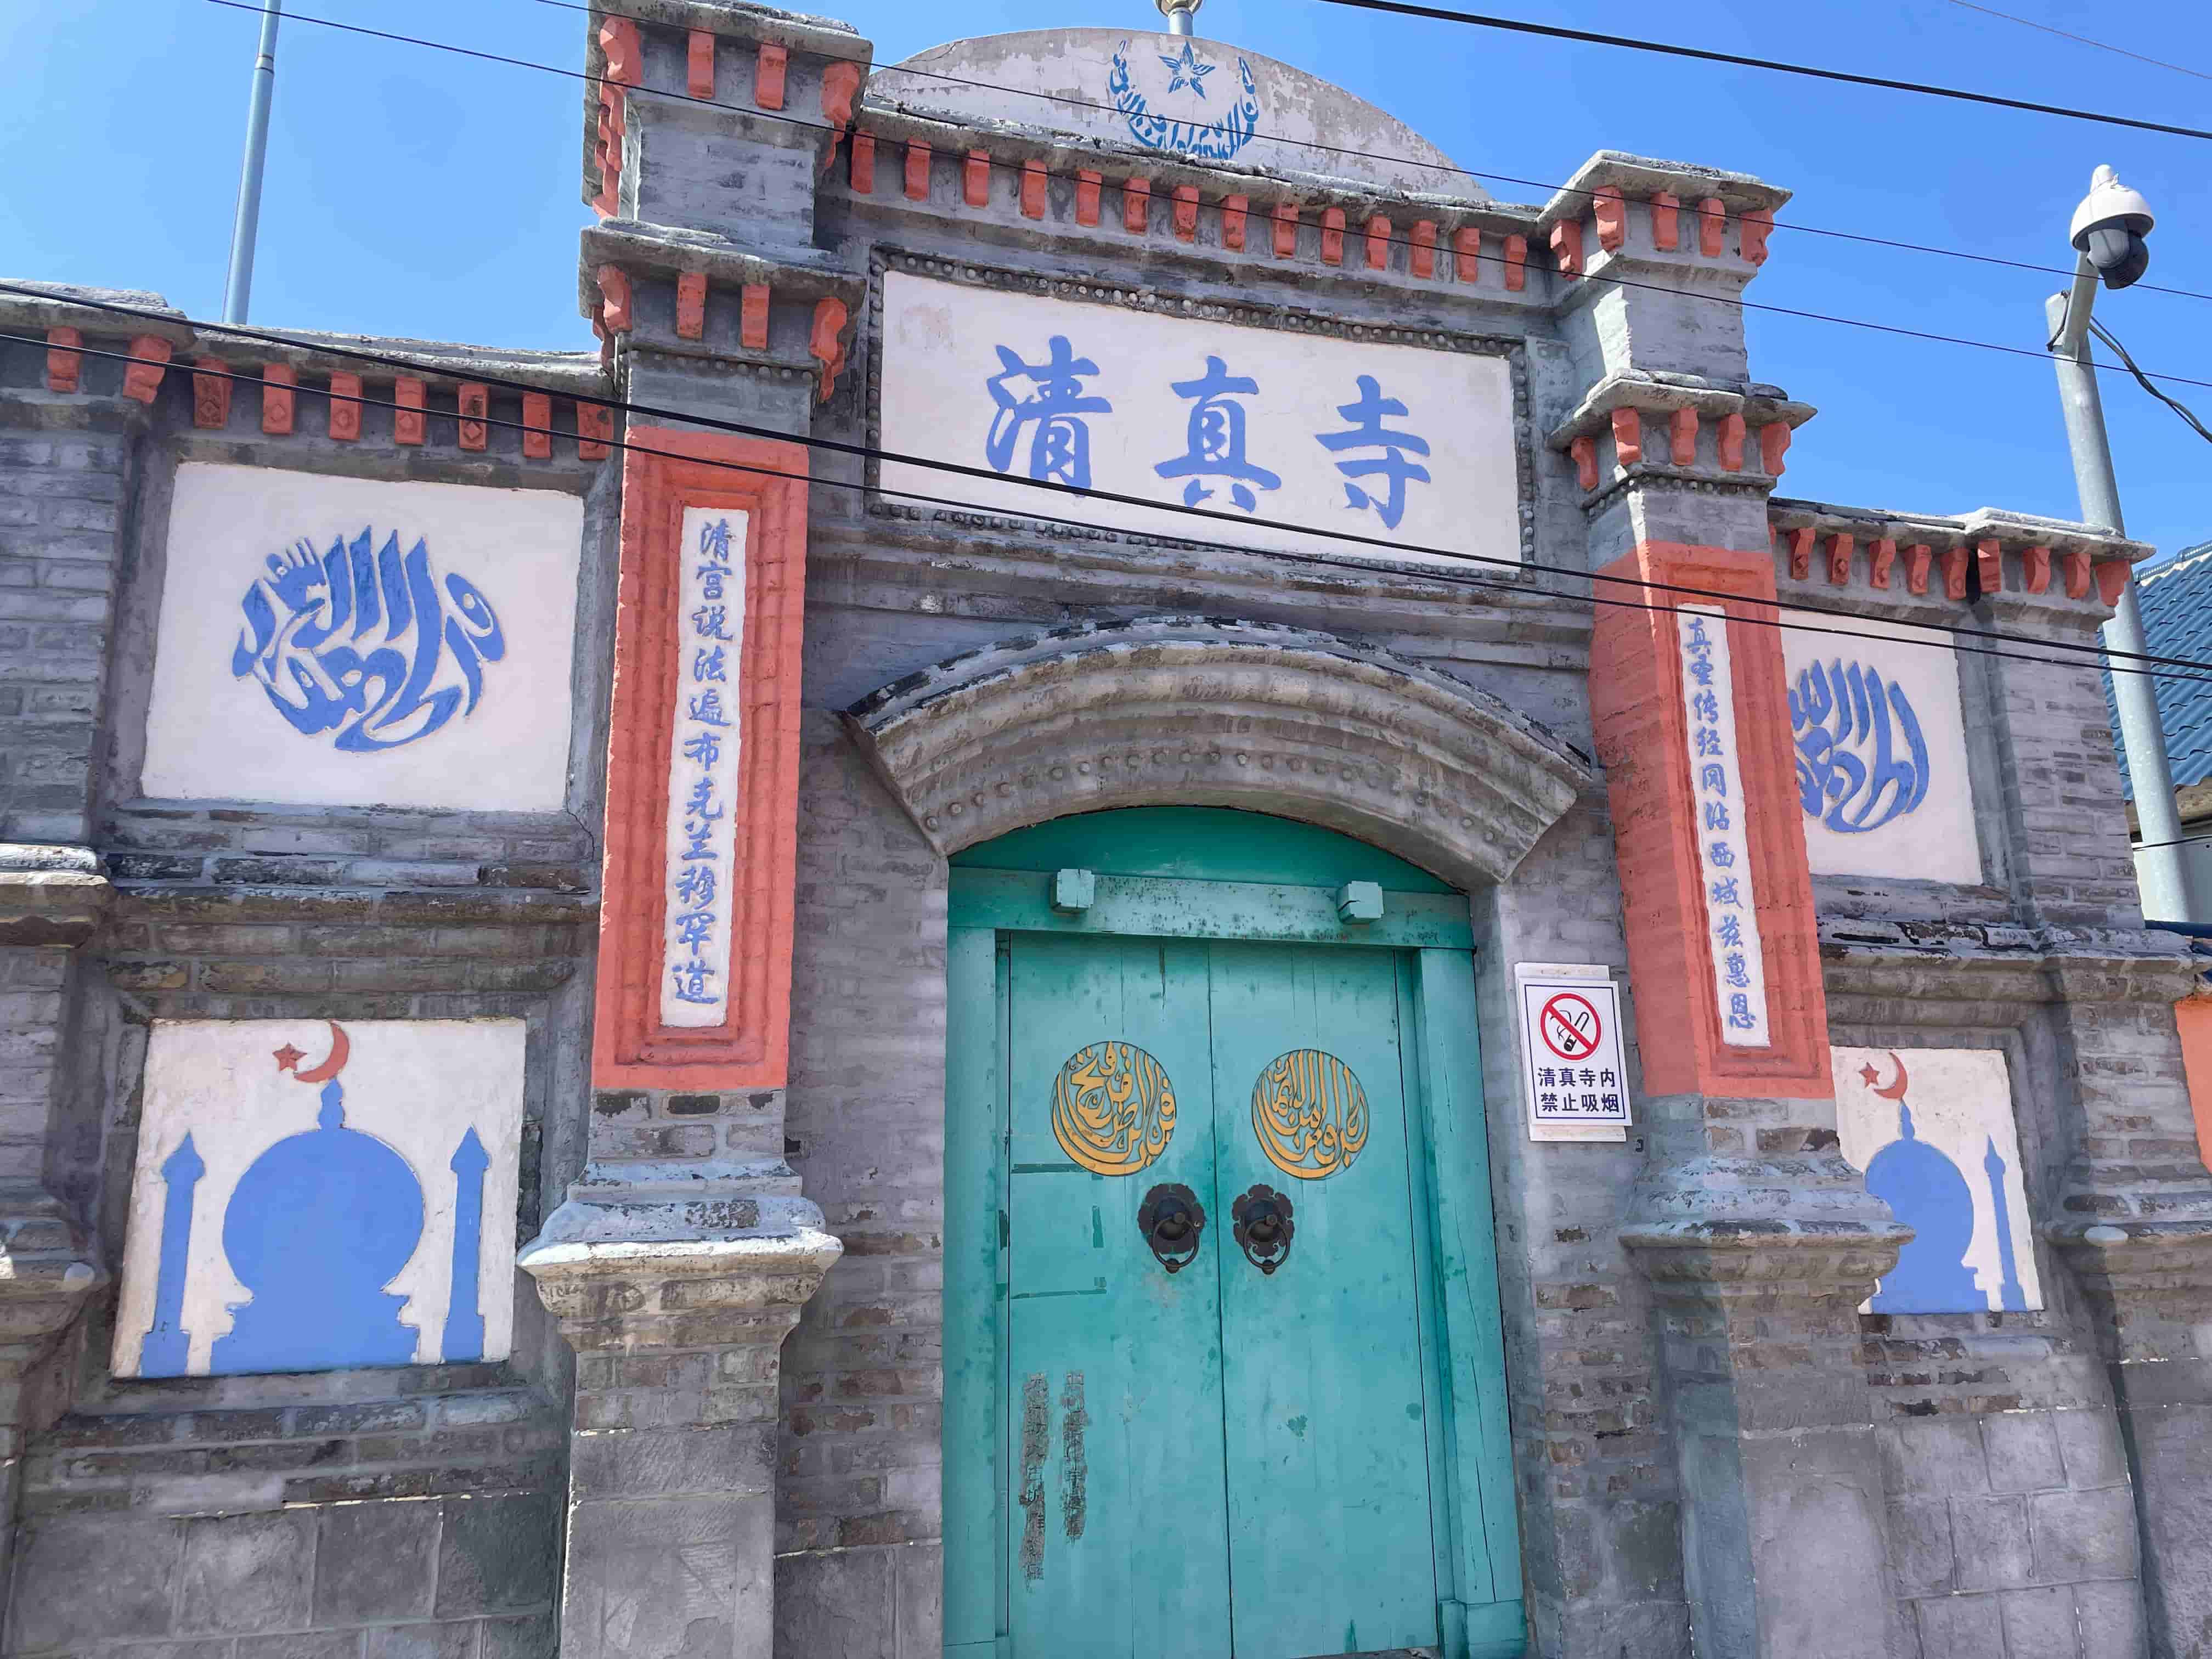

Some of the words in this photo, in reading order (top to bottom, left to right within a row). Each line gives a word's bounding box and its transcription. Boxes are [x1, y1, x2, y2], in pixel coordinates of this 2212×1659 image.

[986, 334, 1431, 531] 清真寺
[1537, 1066, 1616, 1088] 清真寺内
[1540, 1092, 1620, 1113] 禁止吸烟
